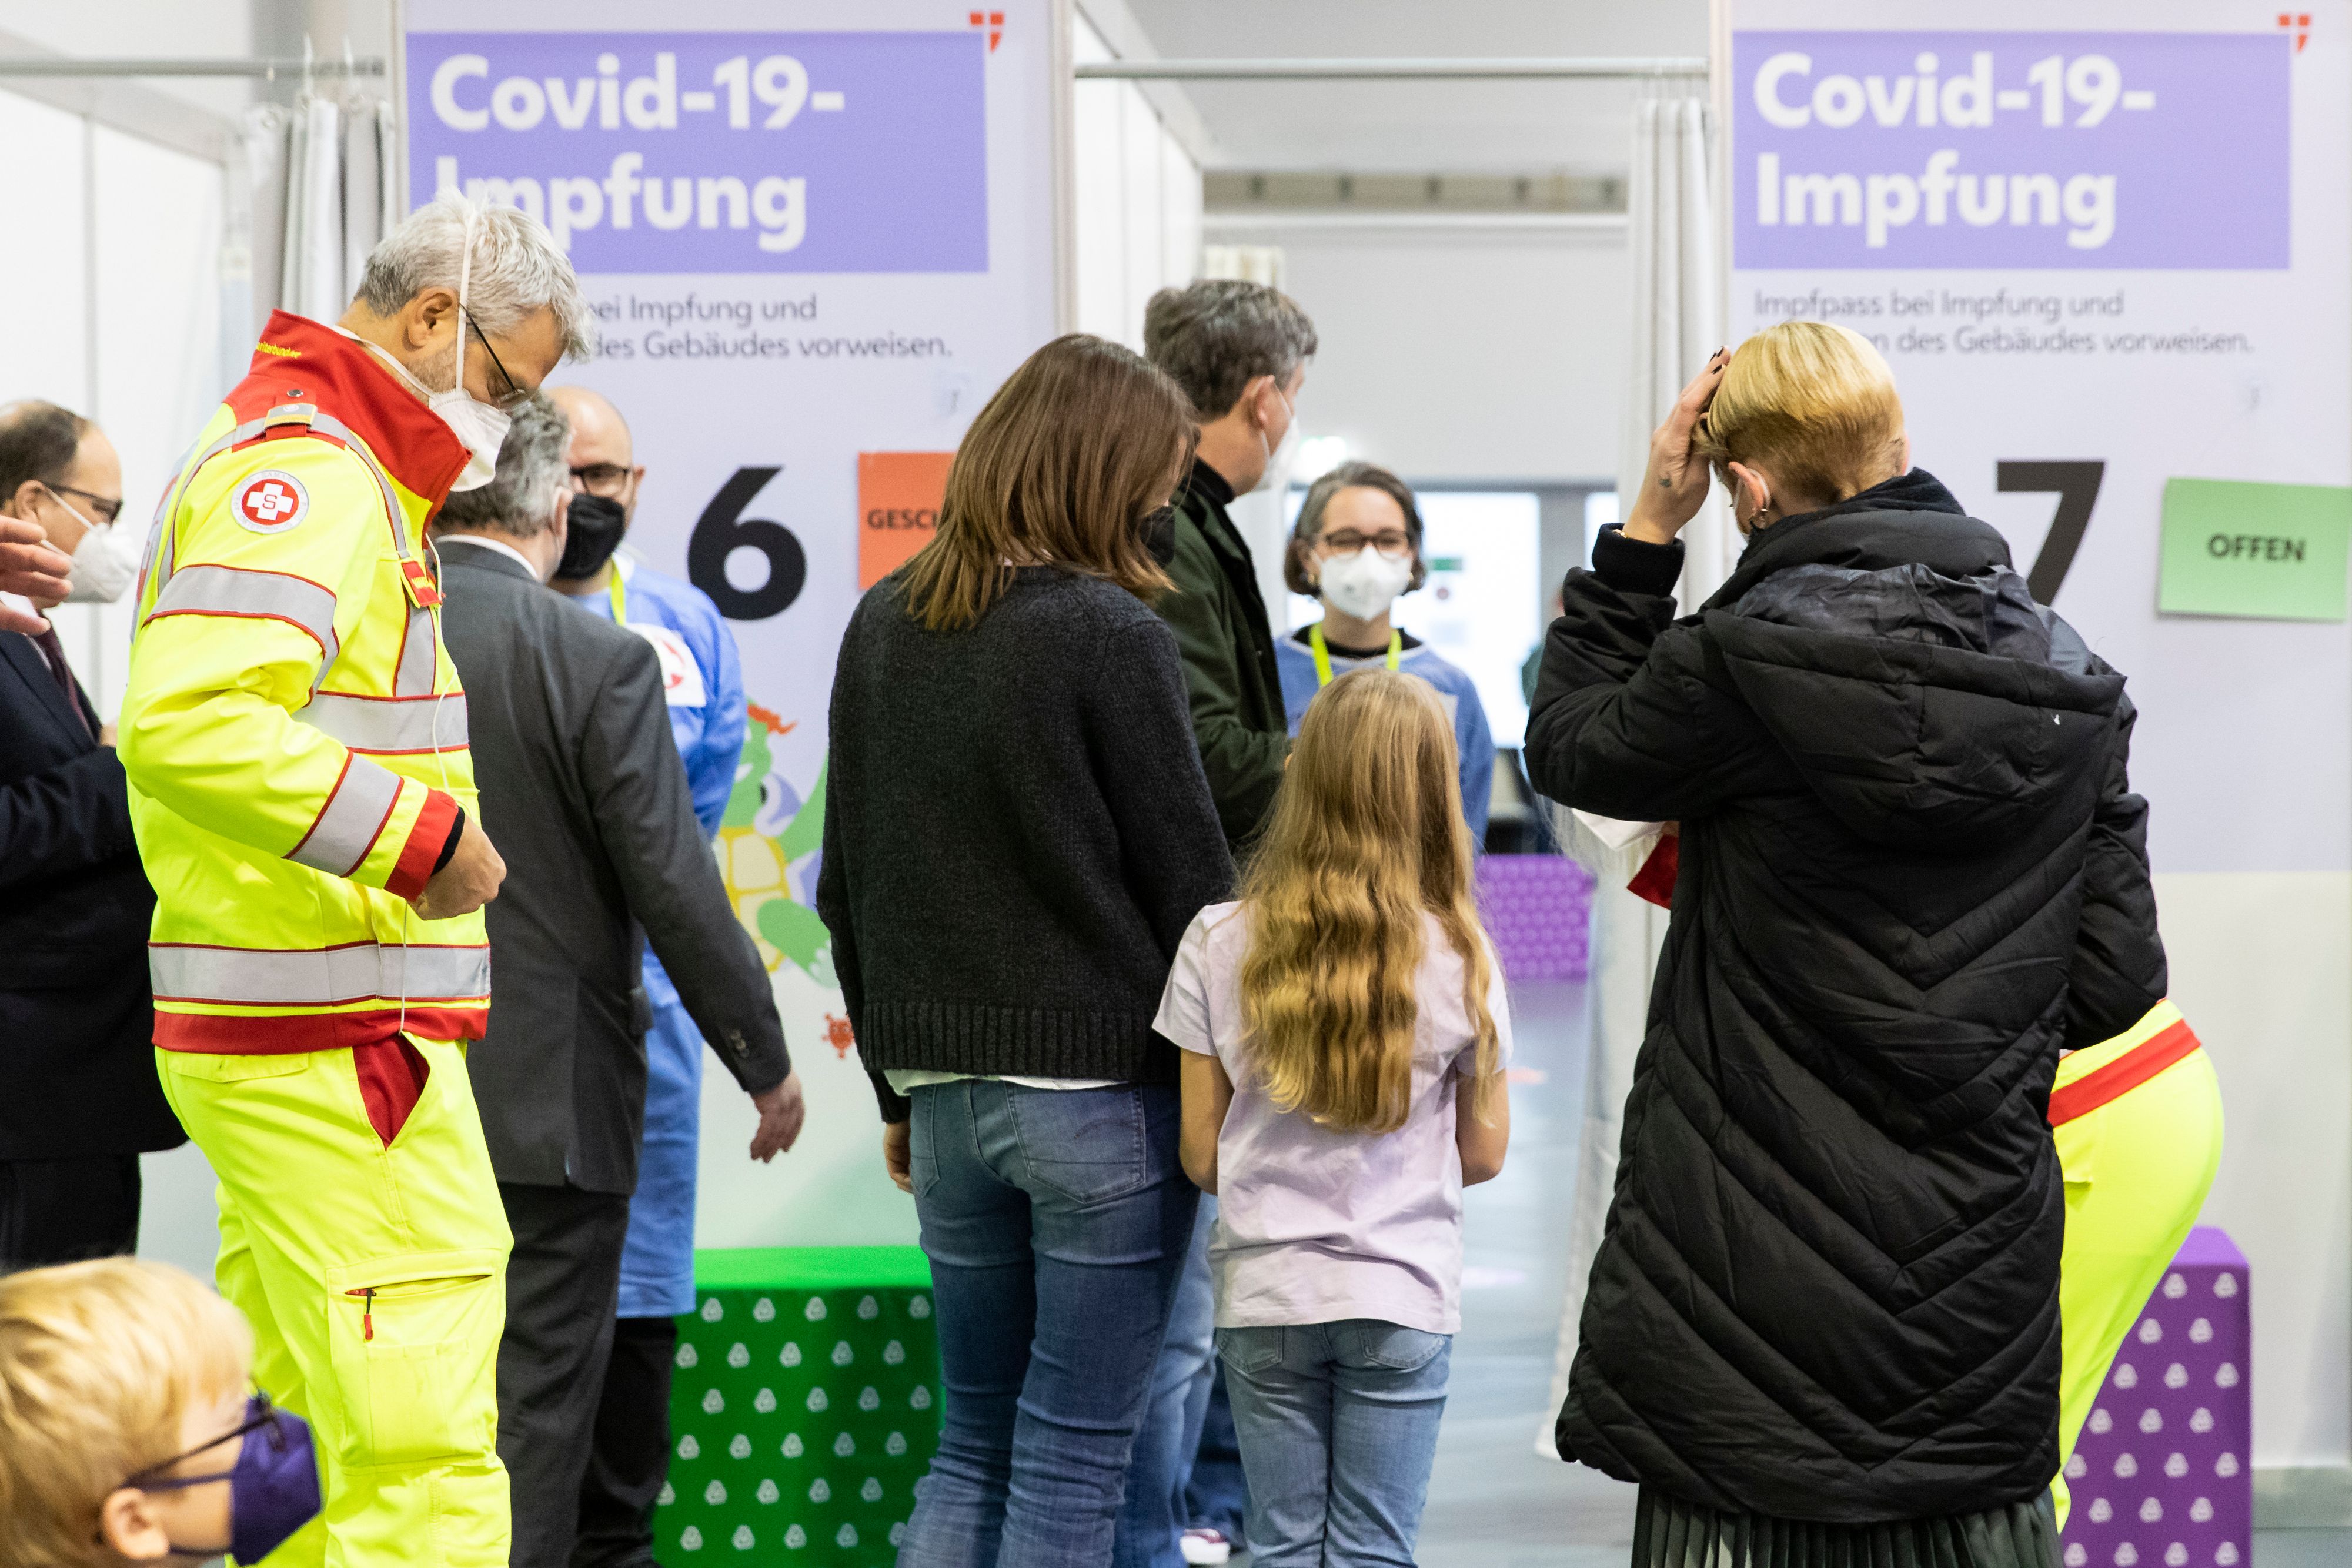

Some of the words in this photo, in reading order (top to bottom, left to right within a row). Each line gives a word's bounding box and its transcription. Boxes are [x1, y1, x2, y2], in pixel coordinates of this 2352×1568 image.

[430, 52, 845, 132] Covid-19-
[1753, 51, 2156, 128] Covid-19-
[1756, 149, 2117, 249] Impfung
[589, 294, 622, 321] ei
[630, 293, 753, 327] Impfung
[763, 293, 817, 320] und
[1754, 287, 1883, 320] Impfpass
[1889, 287, 1935, 316] bei
[1941, 286, 2062, 324] Impfung
[2069, 287, 2125, 316] und
[644, 330, 790, 359] Gebäudes
[797, 330, 953, 358] vorweisen.
[1897, 326, 1947, 353] des
[1953, 324, 2097, 354] Gebäudes
[2102, 325, 2256, 353] vorweisen.
[262, 494, 278, 510] S
[687, 465, 807, 621] 6
[1996, 459, 2106, 608] 7
[2208, 533, 2307, 562] OFFEN
